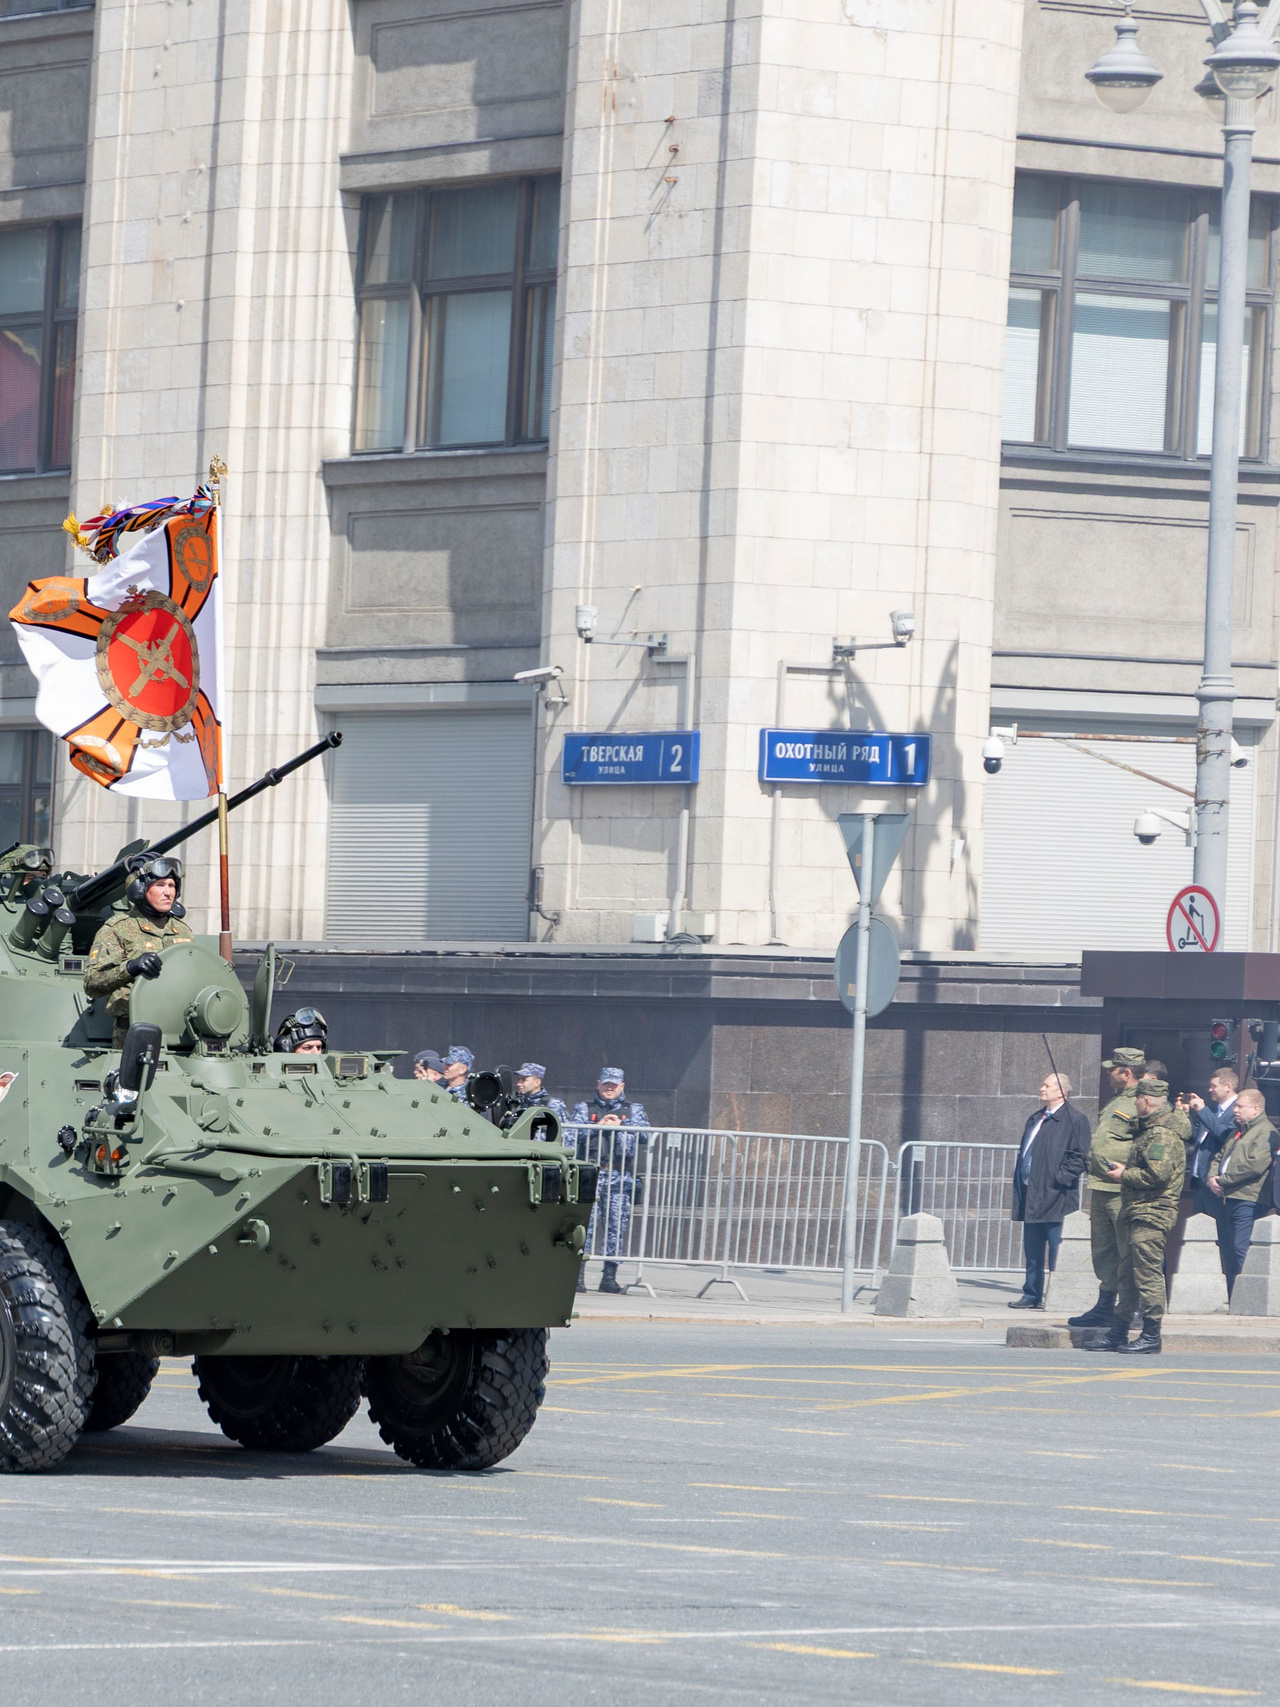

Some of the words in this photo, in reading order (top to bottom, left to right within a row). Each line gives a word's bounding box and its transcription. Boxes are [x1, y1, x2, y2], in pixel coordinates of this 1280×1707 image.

[581, 745, 644, 762] ТВЕРСКАЯ
[670, 744, 683, 772] 2
[775, 742, 847, 760] ОХОТНЫЙ
[852, 745, 880, 764] РЯД
[904, 743, 916, 775] 1
[598, 766, 626, 775] УЛИЦА
[809, 763, 845, 773] УЛИЦА
